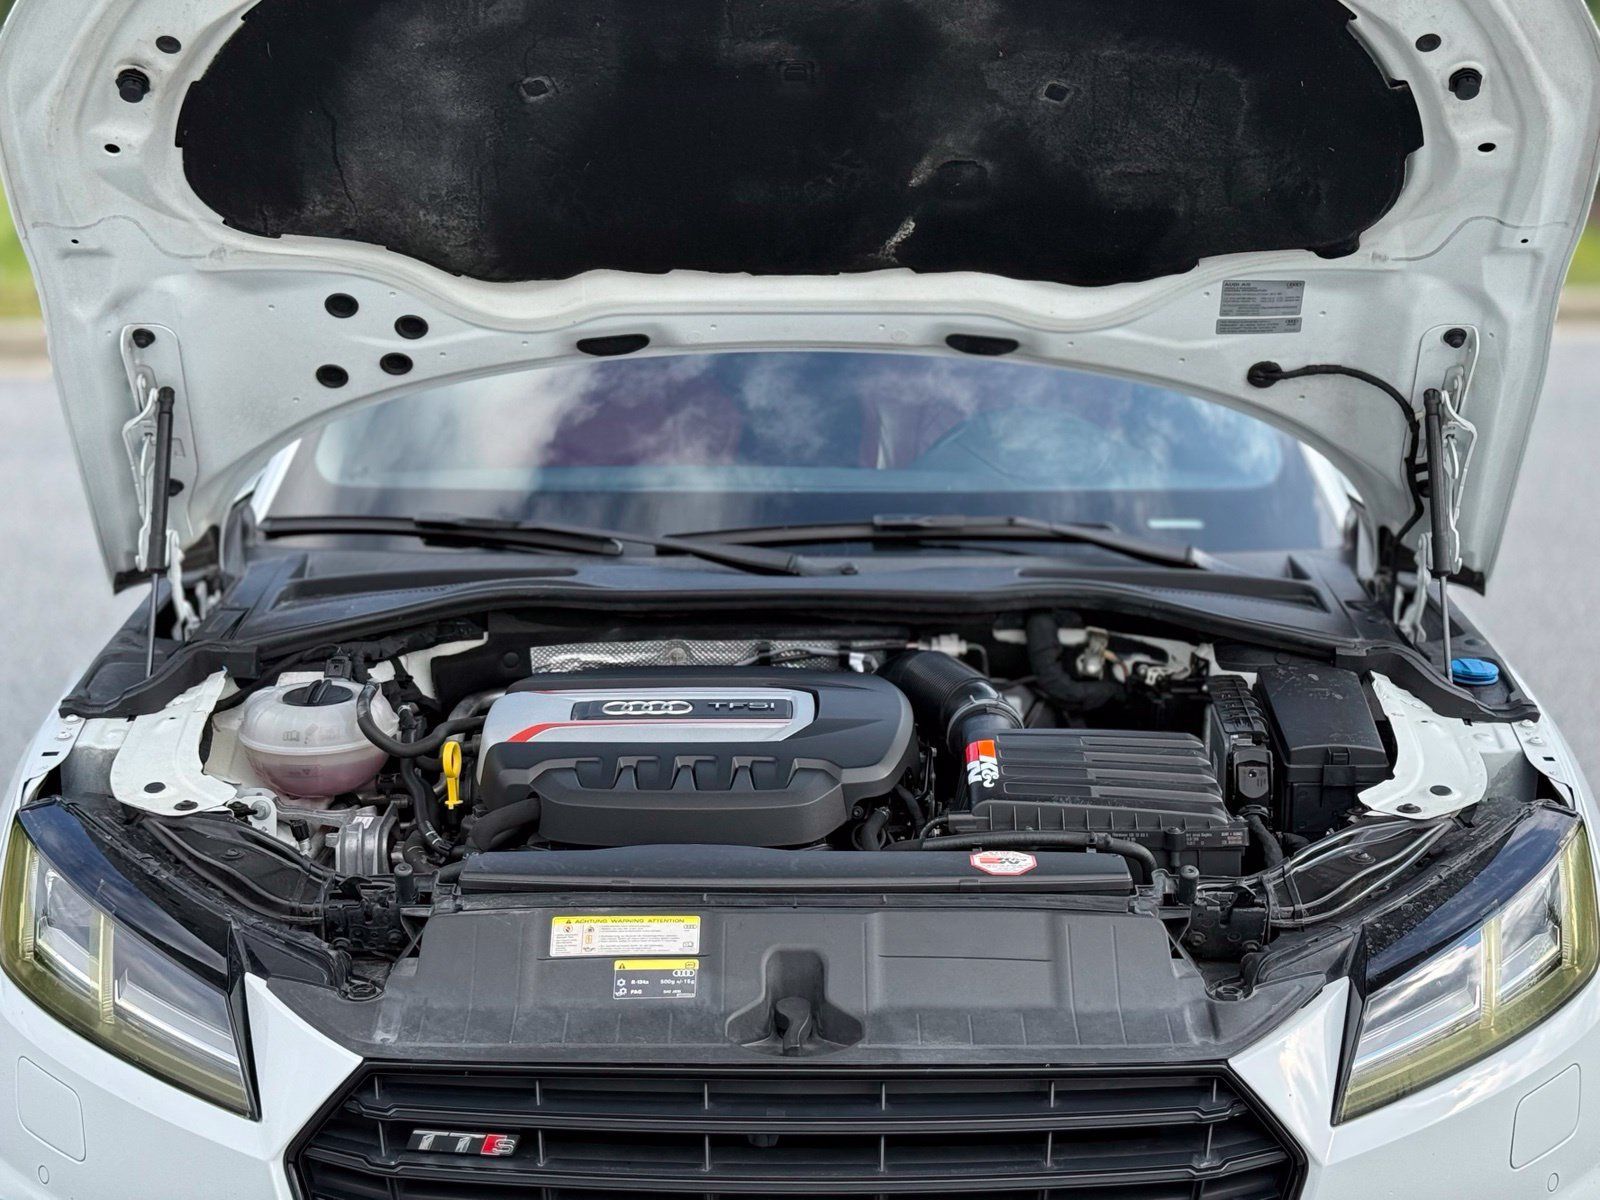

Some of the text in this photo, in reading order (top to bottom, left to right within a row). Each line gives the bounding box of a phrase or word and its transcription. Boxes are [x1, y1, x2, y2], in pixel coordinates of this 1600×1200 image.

[708, 701, 775, 710] TFSI
[966, 755, 999, 788] K&N
[412, 1129, 516, 1156] TTS
